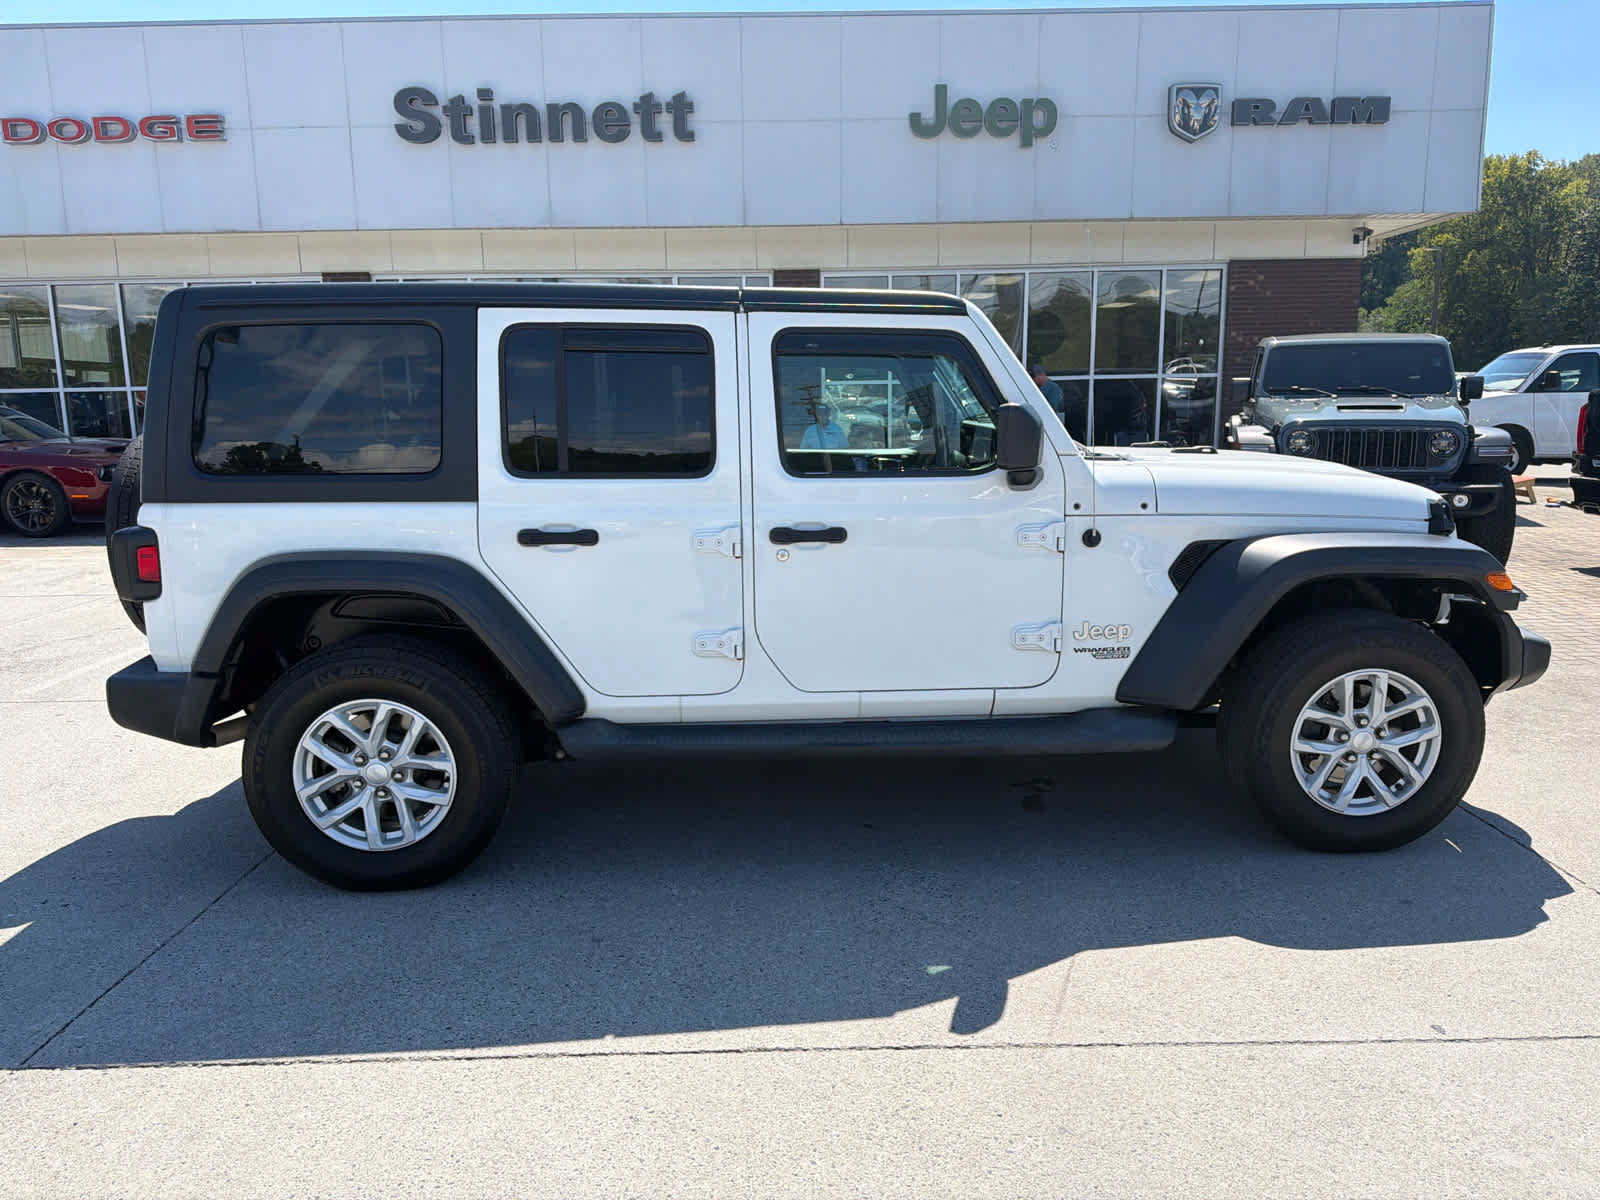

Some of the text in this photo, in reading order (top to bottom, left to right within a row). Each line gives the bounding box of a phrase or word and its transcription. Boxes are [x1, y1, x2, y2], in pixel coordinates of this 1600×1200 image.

[393, 86, 695, 145] Stinnett
[909, 84, 1058, 148] Jeep
[1231, 96, 1391, 126] RAM
[0, 114, 227, 144] DODGE
[1073, 621, 1132, 642] Jeep
